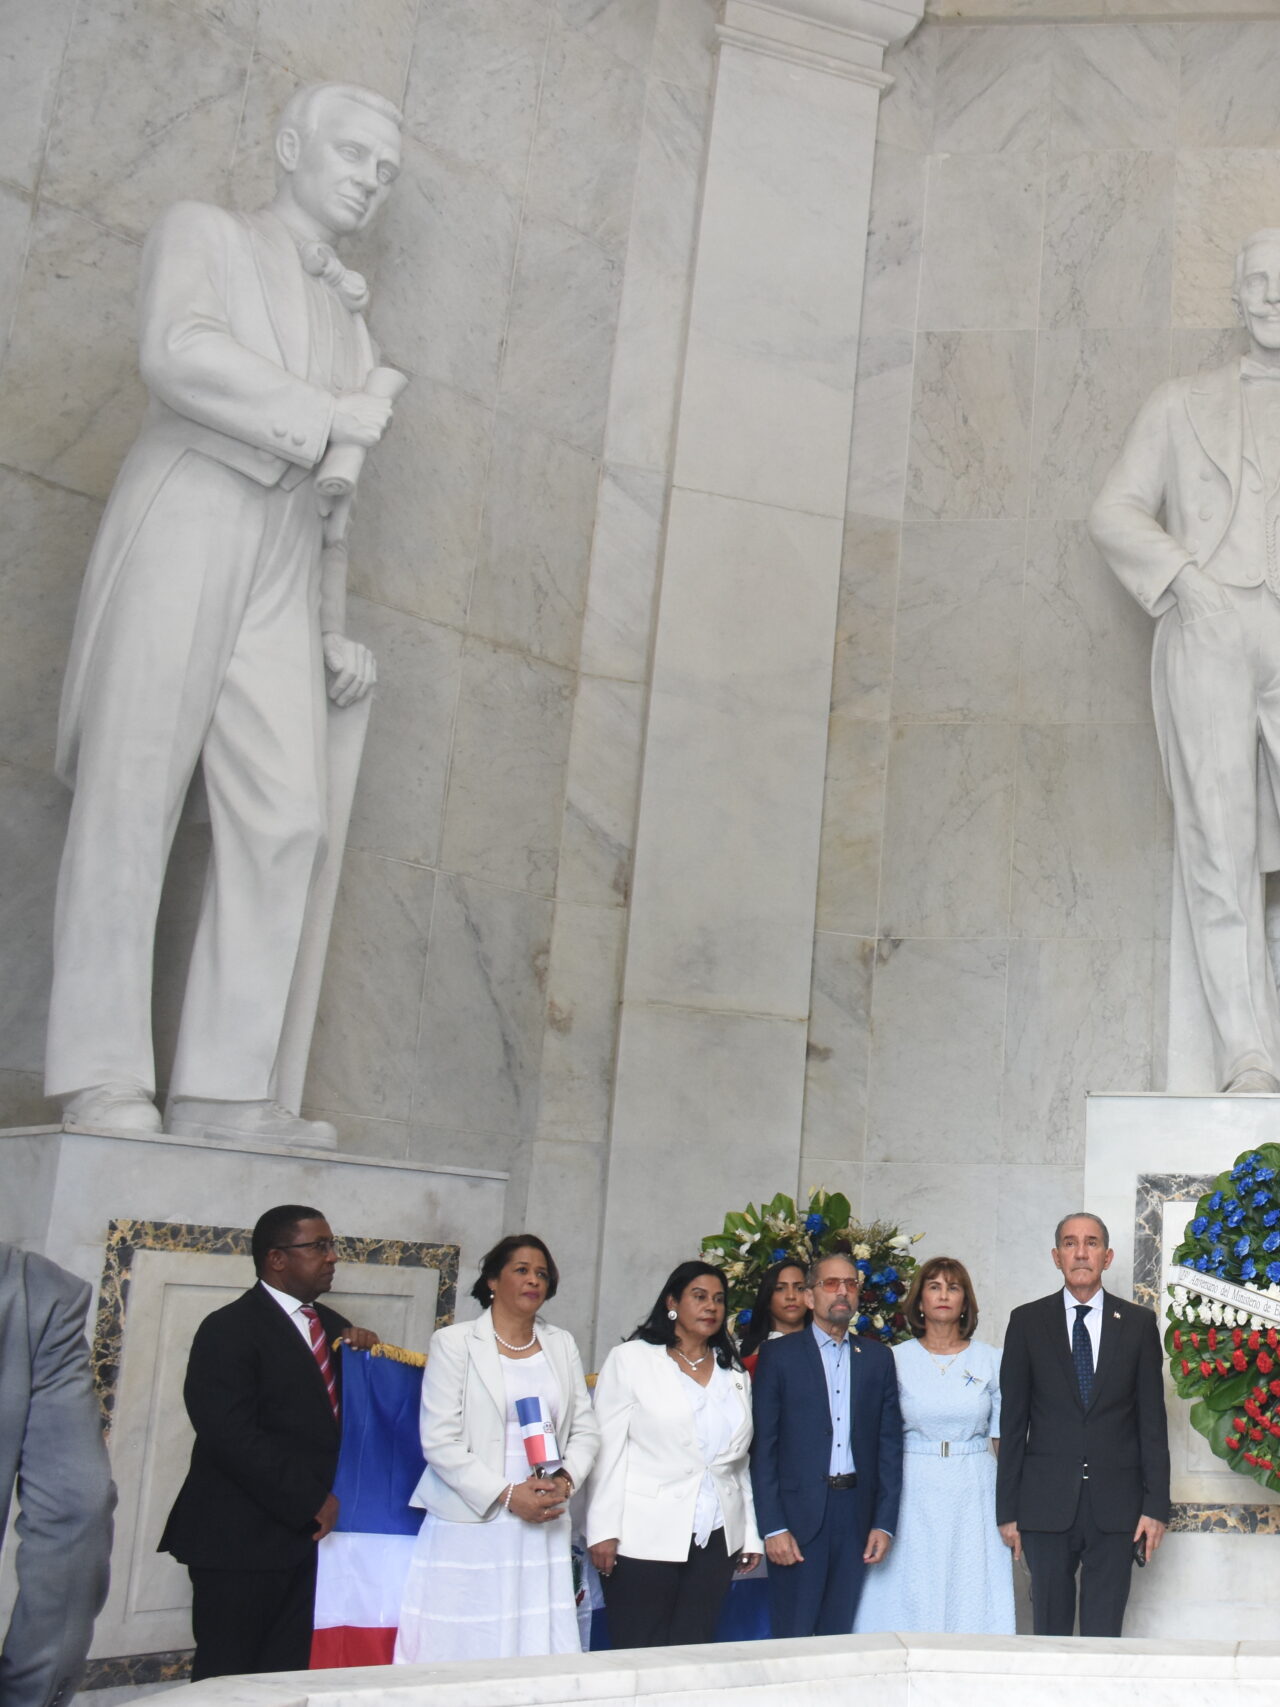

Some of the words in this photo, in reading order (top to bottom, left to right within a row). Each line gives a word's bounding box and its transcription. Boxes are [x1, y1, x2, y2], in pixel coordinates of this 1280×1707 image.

[1191, 1274, 1218, 1294] Aniversario
[1221, 1285, 1231, 1297] del
[1232, 1288, 1260, 1309] Ministerio
[1263, 1300, 1271, 1313] de
